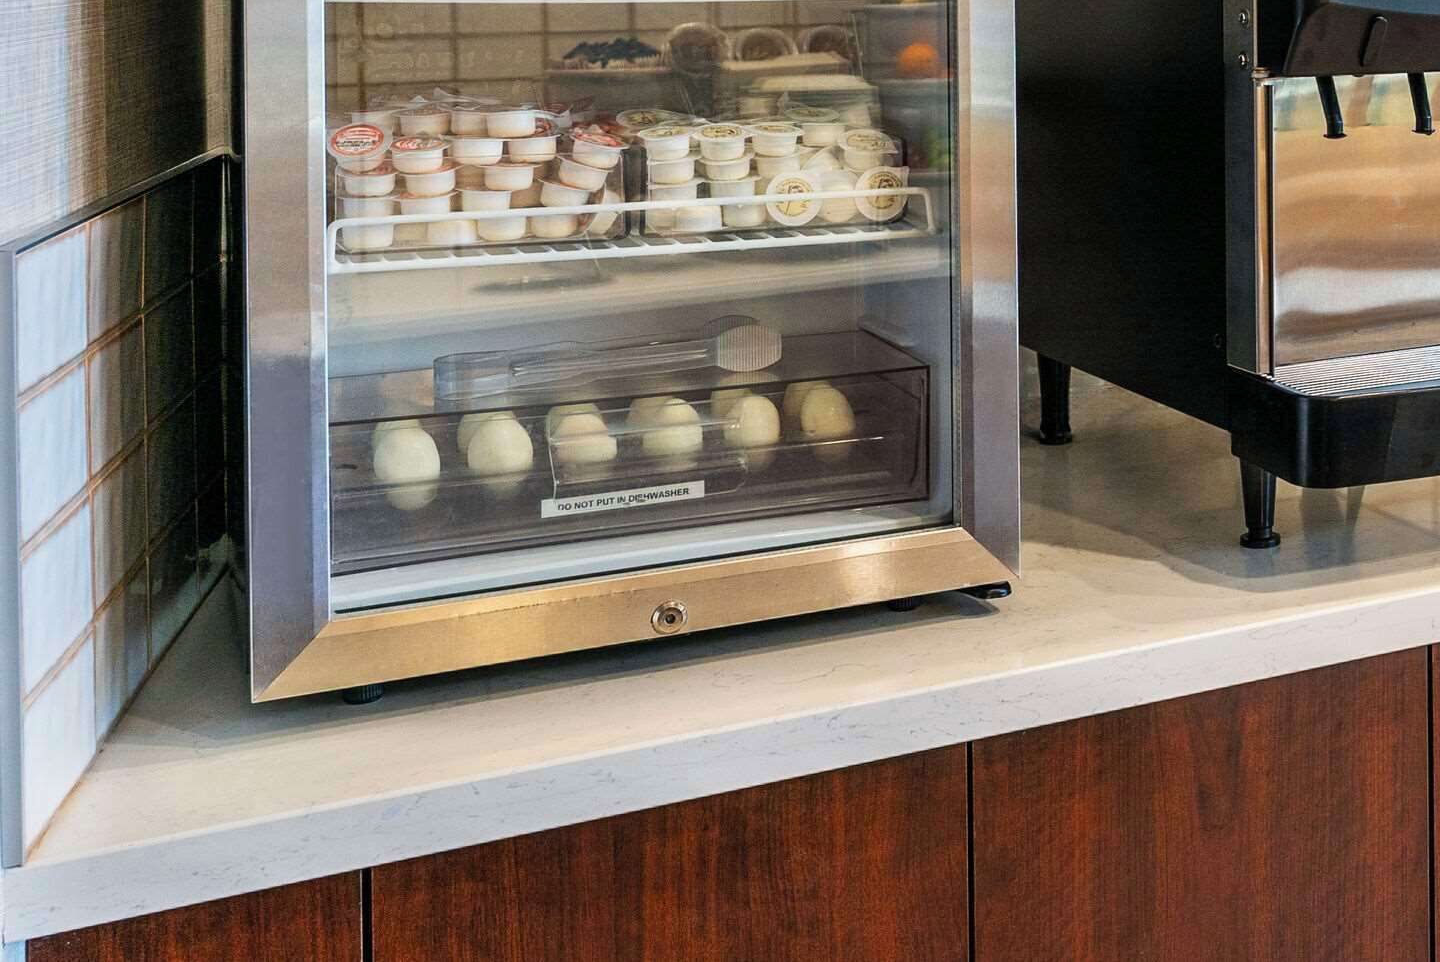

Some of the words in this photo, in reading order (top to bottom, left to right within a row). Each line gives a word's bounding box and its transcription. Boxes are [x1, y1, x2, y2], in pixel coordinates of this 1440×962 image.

[557, 502, 572, 511] DO
[574, 500, 594, 510] NOT
[596, 498, 615, 507] PUT
[617, 496, 627, 505] IN
[628, 487, 691, 503] DISHWASHER
